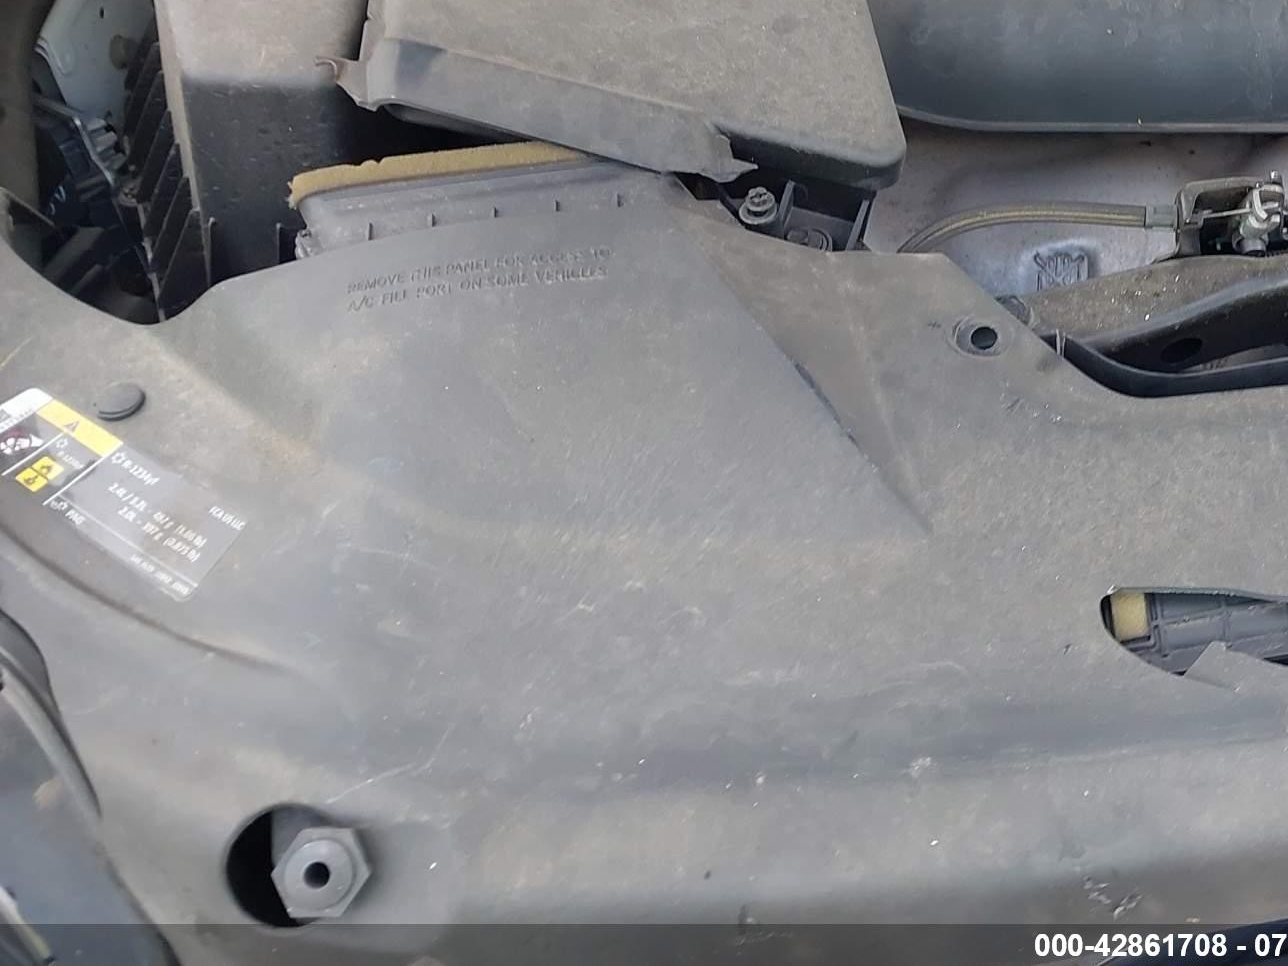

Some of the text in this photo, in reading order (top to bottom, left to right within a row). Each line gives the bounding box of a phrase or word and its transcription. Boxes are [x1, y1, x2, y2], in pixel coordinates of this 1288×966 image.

[348, 273, 405, 295] REMOVE
[446, 257, 490, 276] PANEL
[494, 253, 523, 270] FOR
[348, 266, 609, 312] A/C FILL PORT ON SOME VEHICLES
